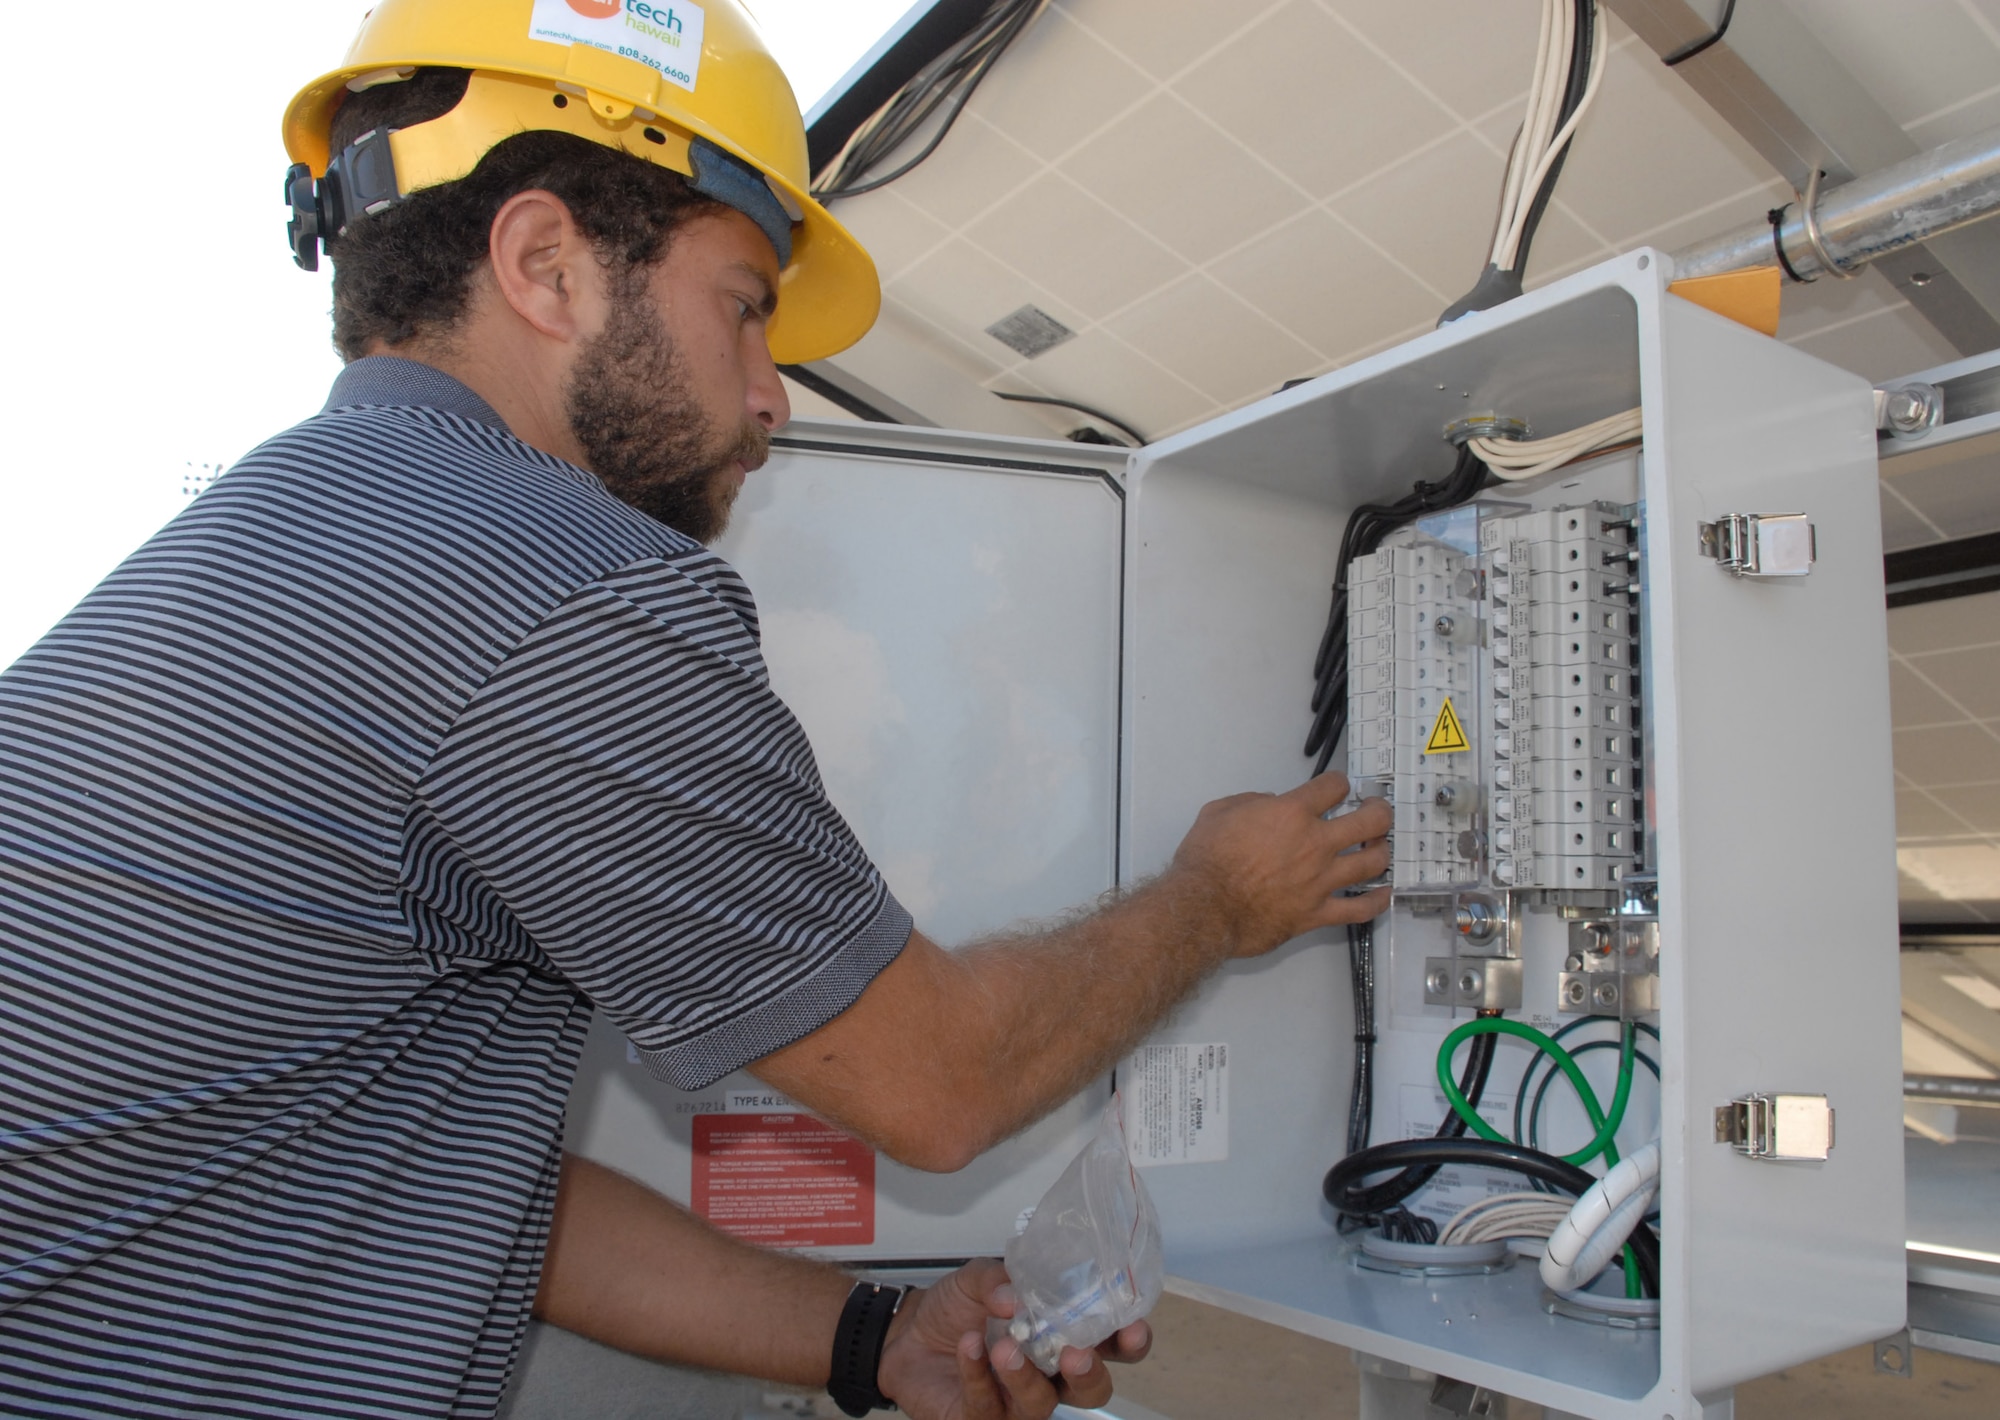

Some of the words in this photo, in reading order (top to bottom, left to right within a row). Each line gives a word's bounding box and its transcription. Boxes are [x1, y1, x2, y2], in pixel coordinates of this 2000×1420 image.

[626, 0, 682, 33] tech
[625, 13, 681, 48] hawaii
[618, 45, 690, 83] 808.262.6600
[1189, 1067, 1197, 1084] TYPE
[733, 1096, 759, 1106] TYPE
[761, 1096, 774, 1106] 4X
[761, 1115, 795, 1124] CAUTION
